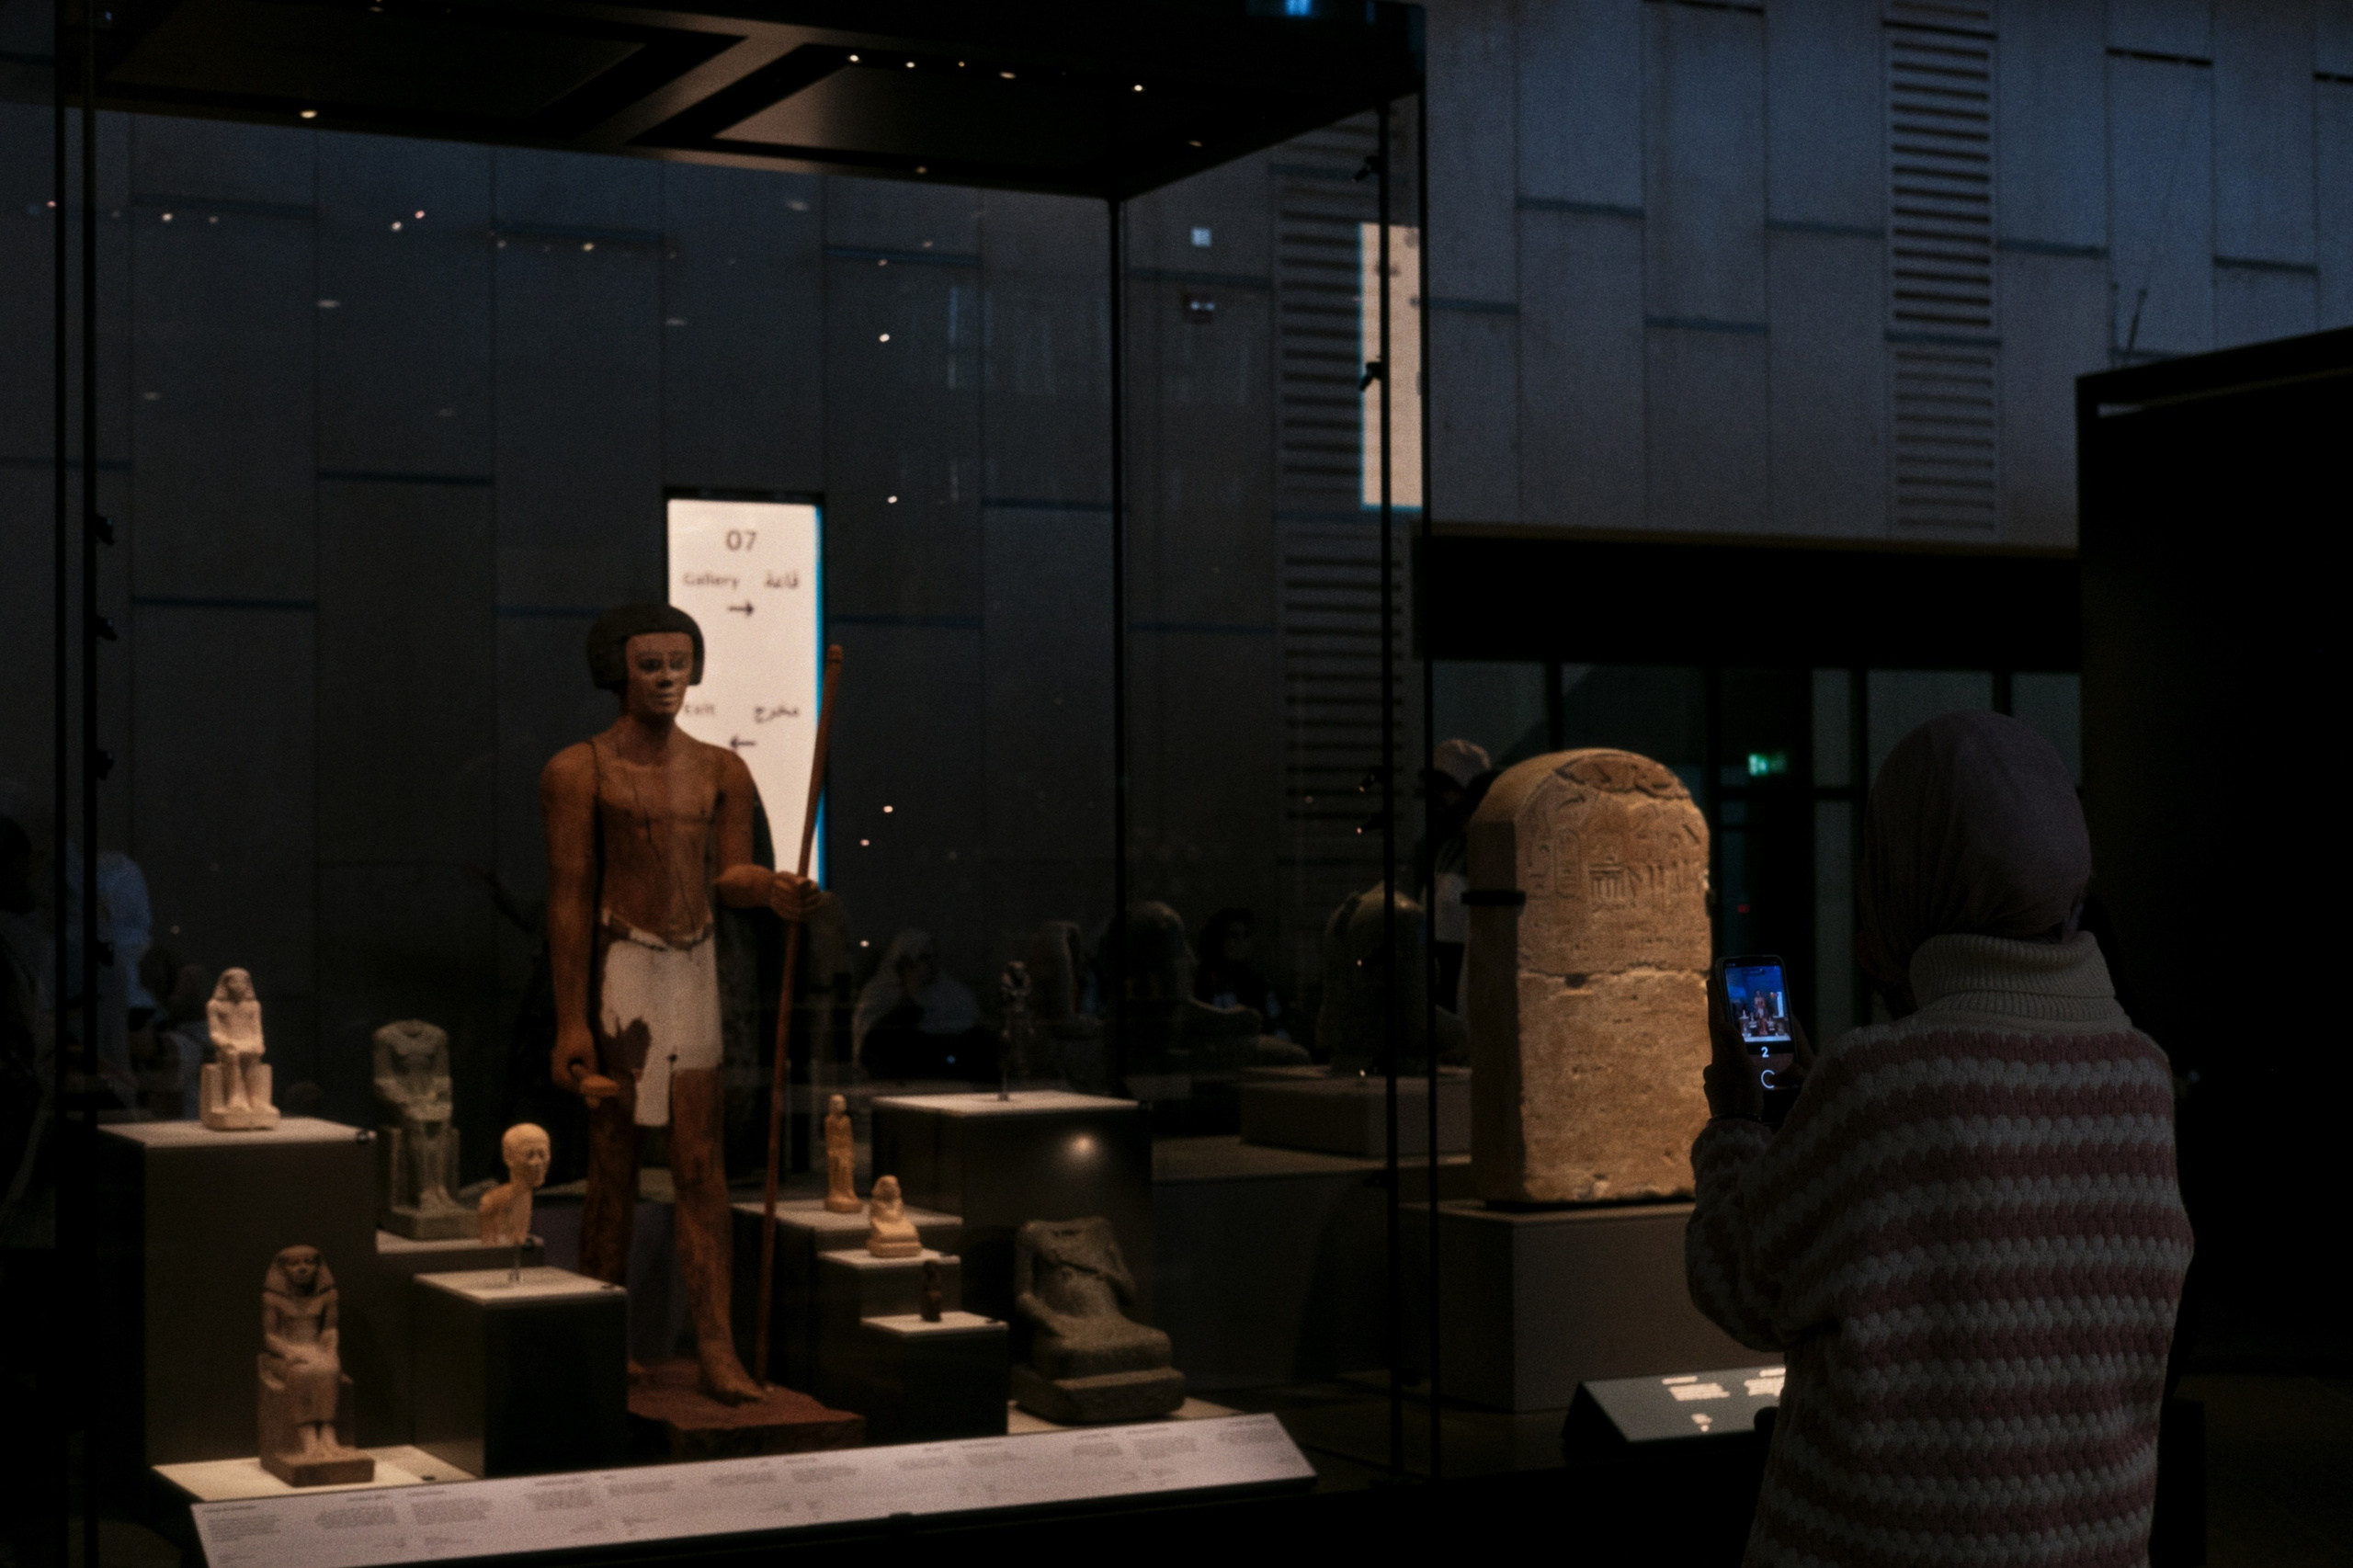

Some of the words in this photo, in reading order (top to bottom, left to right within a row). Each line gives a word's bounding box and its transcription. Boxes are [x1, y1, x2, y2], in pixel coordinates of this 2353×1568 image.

[725, 529, 756, 551] 07
[683, 572, 739, 591] Gallery
[1760, 1046, 1769, 1058] 2
